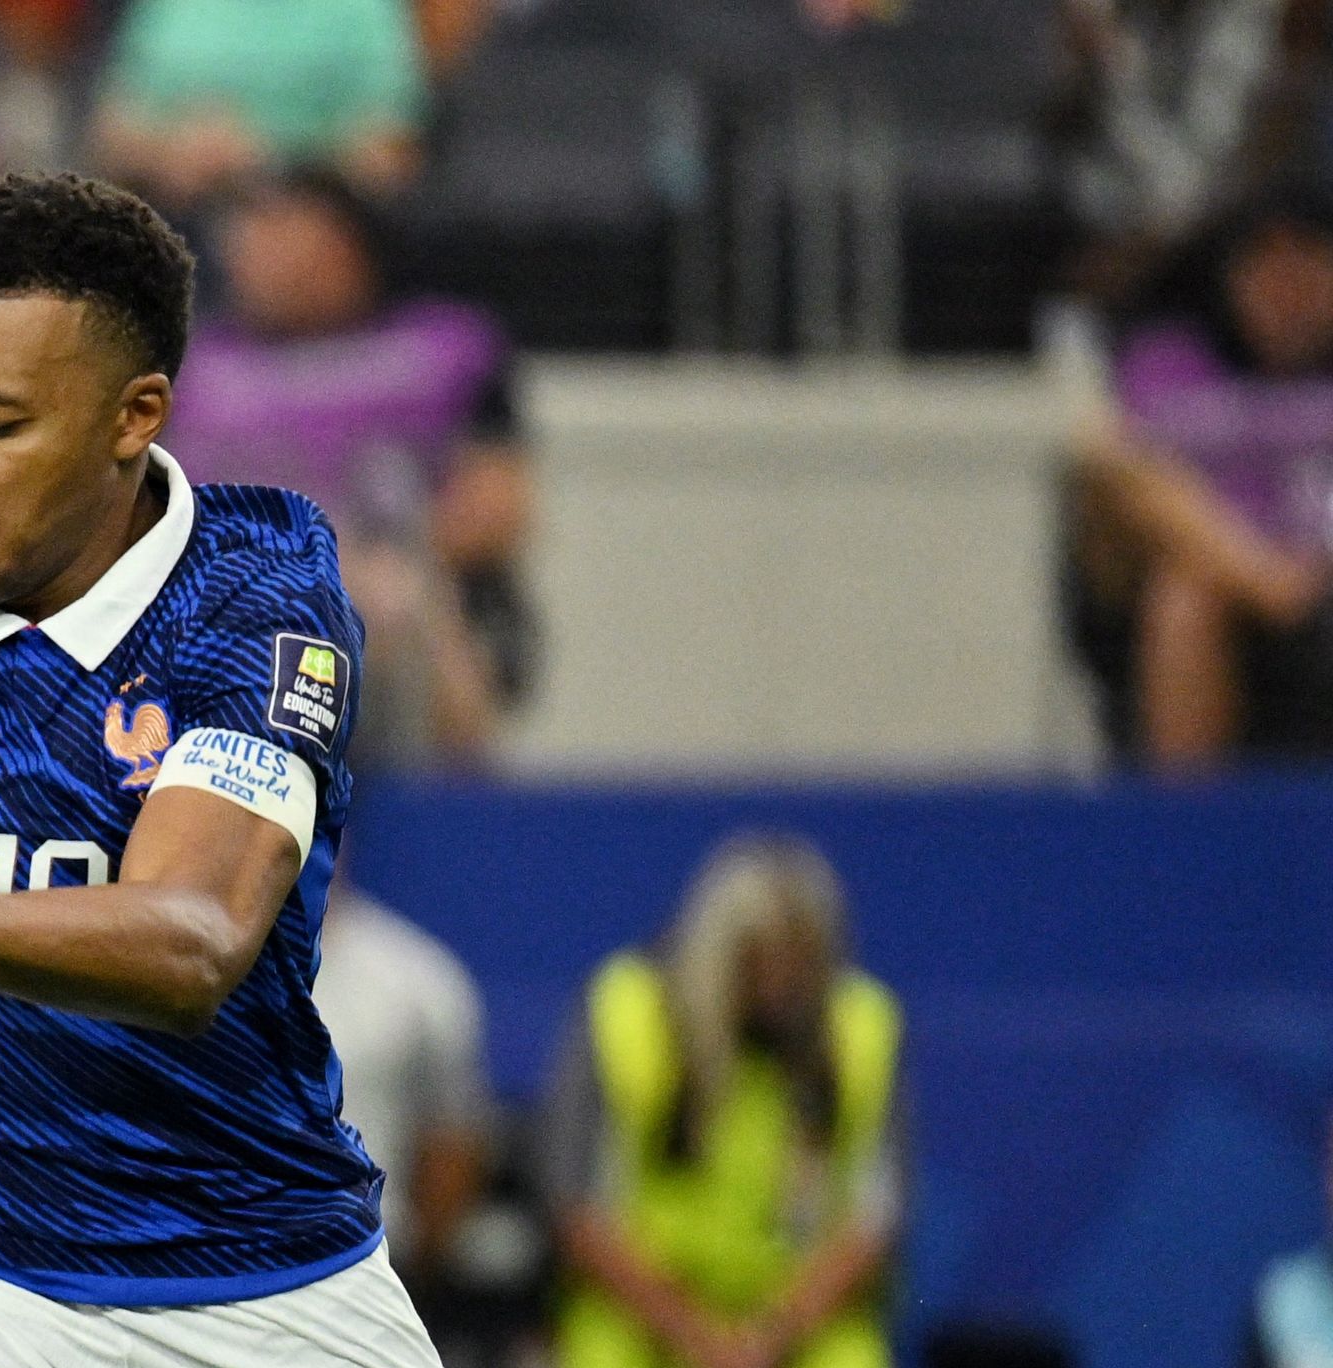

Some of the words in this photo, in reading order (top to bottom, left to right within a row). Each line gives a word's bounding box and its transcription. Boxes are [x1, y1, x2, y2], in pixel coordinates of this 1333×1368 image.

[299, 715, 320, 734] FIFA
[192, 731, 288, 777] UNITES
[184, 750, 220, 768] the
[224, 758, 290, 802] World
[210, 774, 255, 802] FIFA
